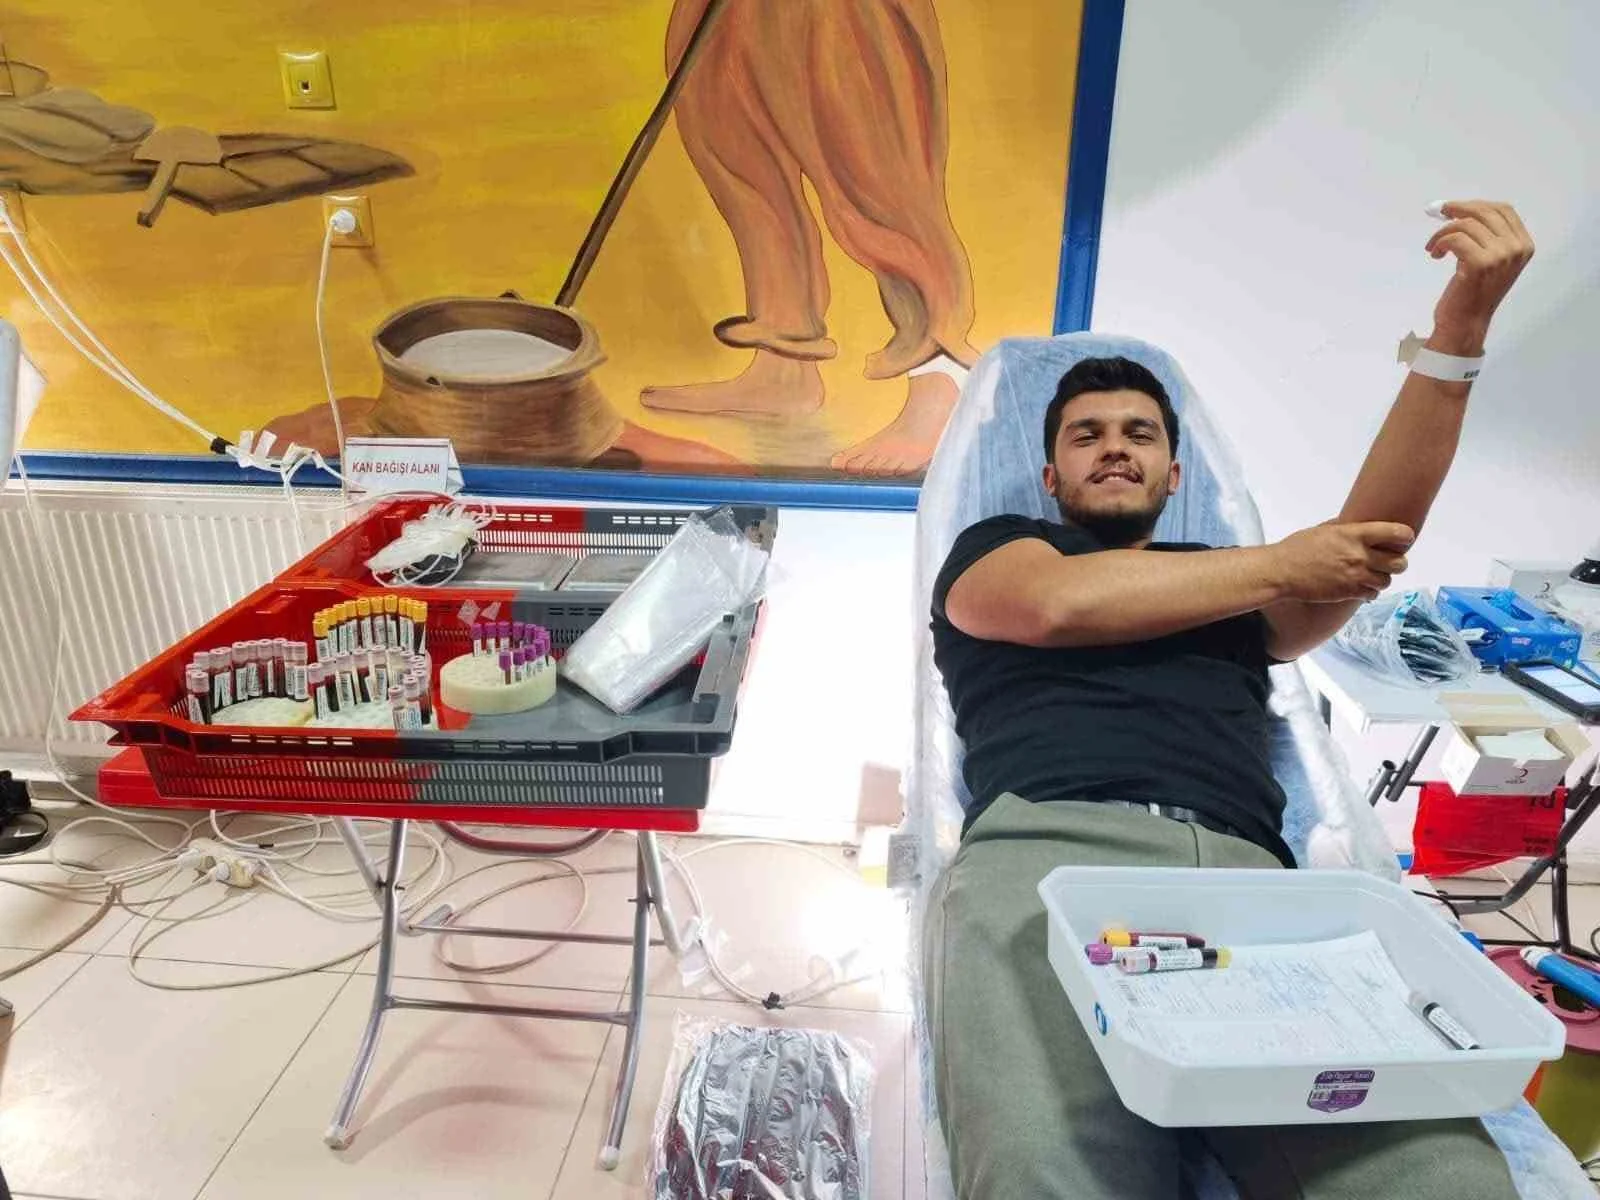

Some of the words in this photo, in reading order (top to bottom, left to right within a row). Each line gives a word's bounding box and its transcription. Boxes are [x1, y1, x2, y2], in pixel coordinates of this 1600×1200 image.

[352, 462, 373, 473] KAN
[375, 461, 408, 476] BAĞIŞI
[410, 462, 440, 474] ALANI
